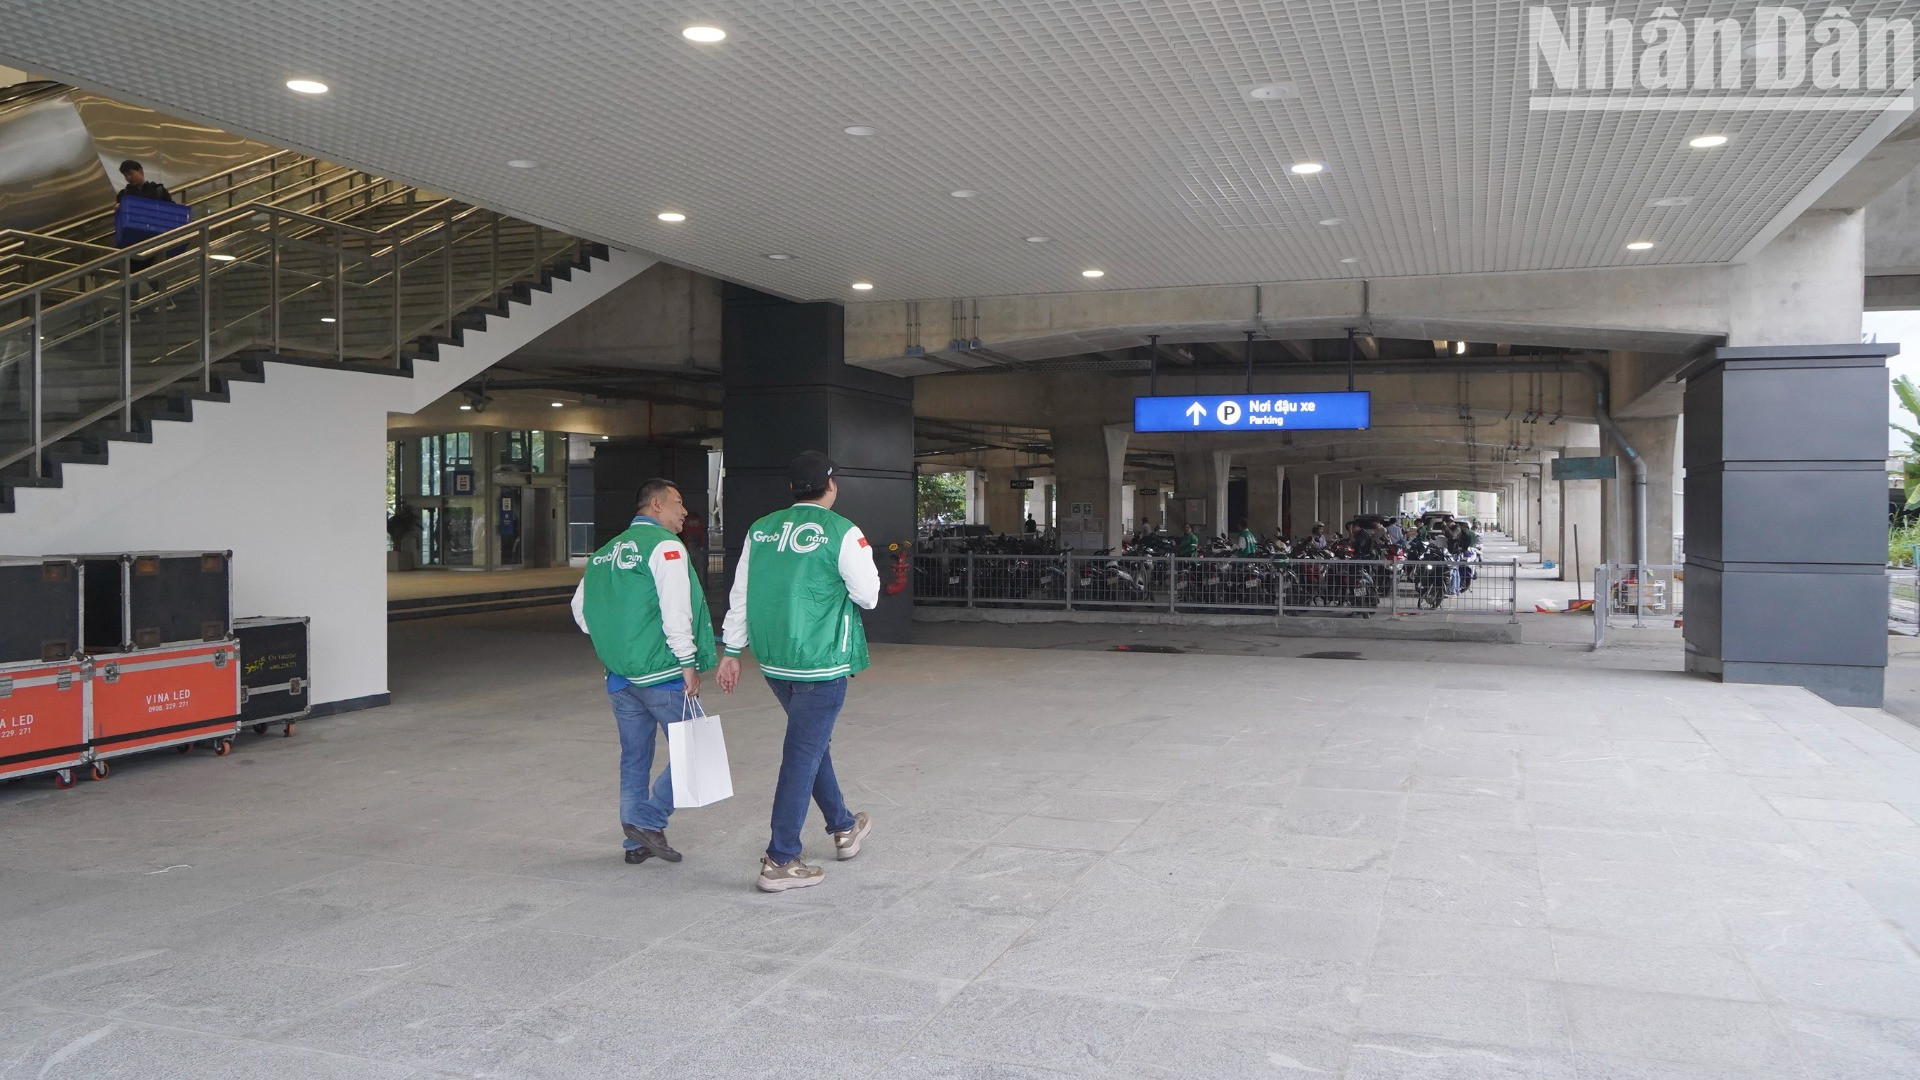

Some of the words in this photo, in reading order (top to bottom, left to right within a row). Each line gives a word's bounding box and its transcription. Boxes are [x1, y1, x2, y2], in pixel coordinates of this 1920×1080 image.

[1224, 406, 1235, 420] P
[1249, 400, 1271, 412] Nơi
[1274, 400, 1297, 414] đậu
[1300, 402, 1316, 412] xe
[1249, 416, 1284, 426] Parking
[753, 531, 780, 542] Grab
[777, 522, 824, 553] 10
[805, 534, 829, 544] năm
[146, 693, 170, 704] VINA
[173, 690, 191, 701] LED
[12, 714, 34, 727] LED
